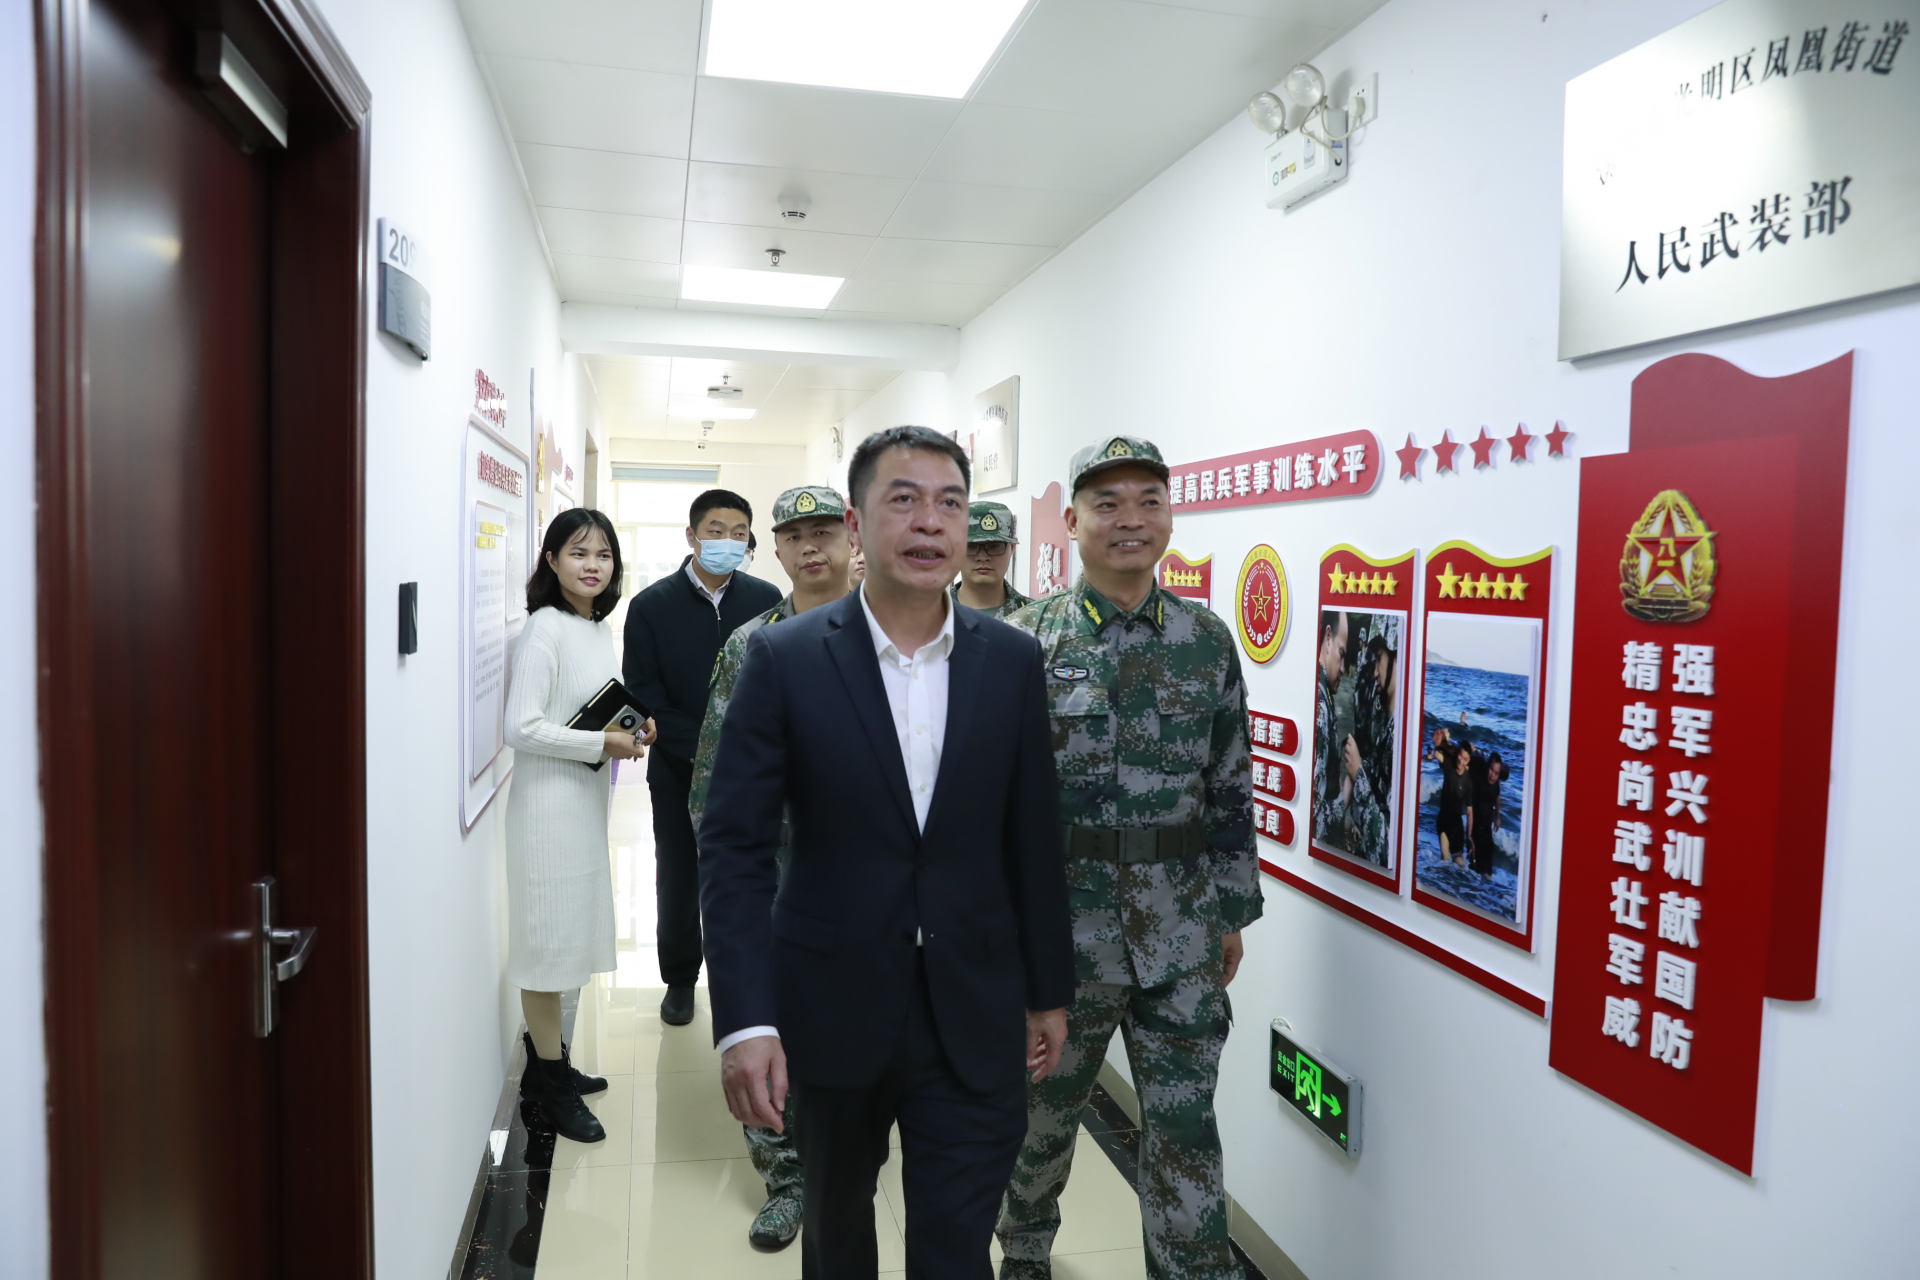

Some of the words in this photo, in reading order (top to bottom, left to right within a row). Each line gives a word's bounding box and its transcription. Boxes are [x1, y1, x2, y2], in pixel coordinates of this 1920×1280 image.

[1615, 176, 1853, 294] 人民武装部
[1169, 443, 1367, 506] 提高民兵军事训练水平
[1601, 640, 1663, 1048] 精忠尚武壮军威
[1649, 643, 1716, 1070] 强军兴训献国防
[1277, 1063, 1296, 1084] EXIT
